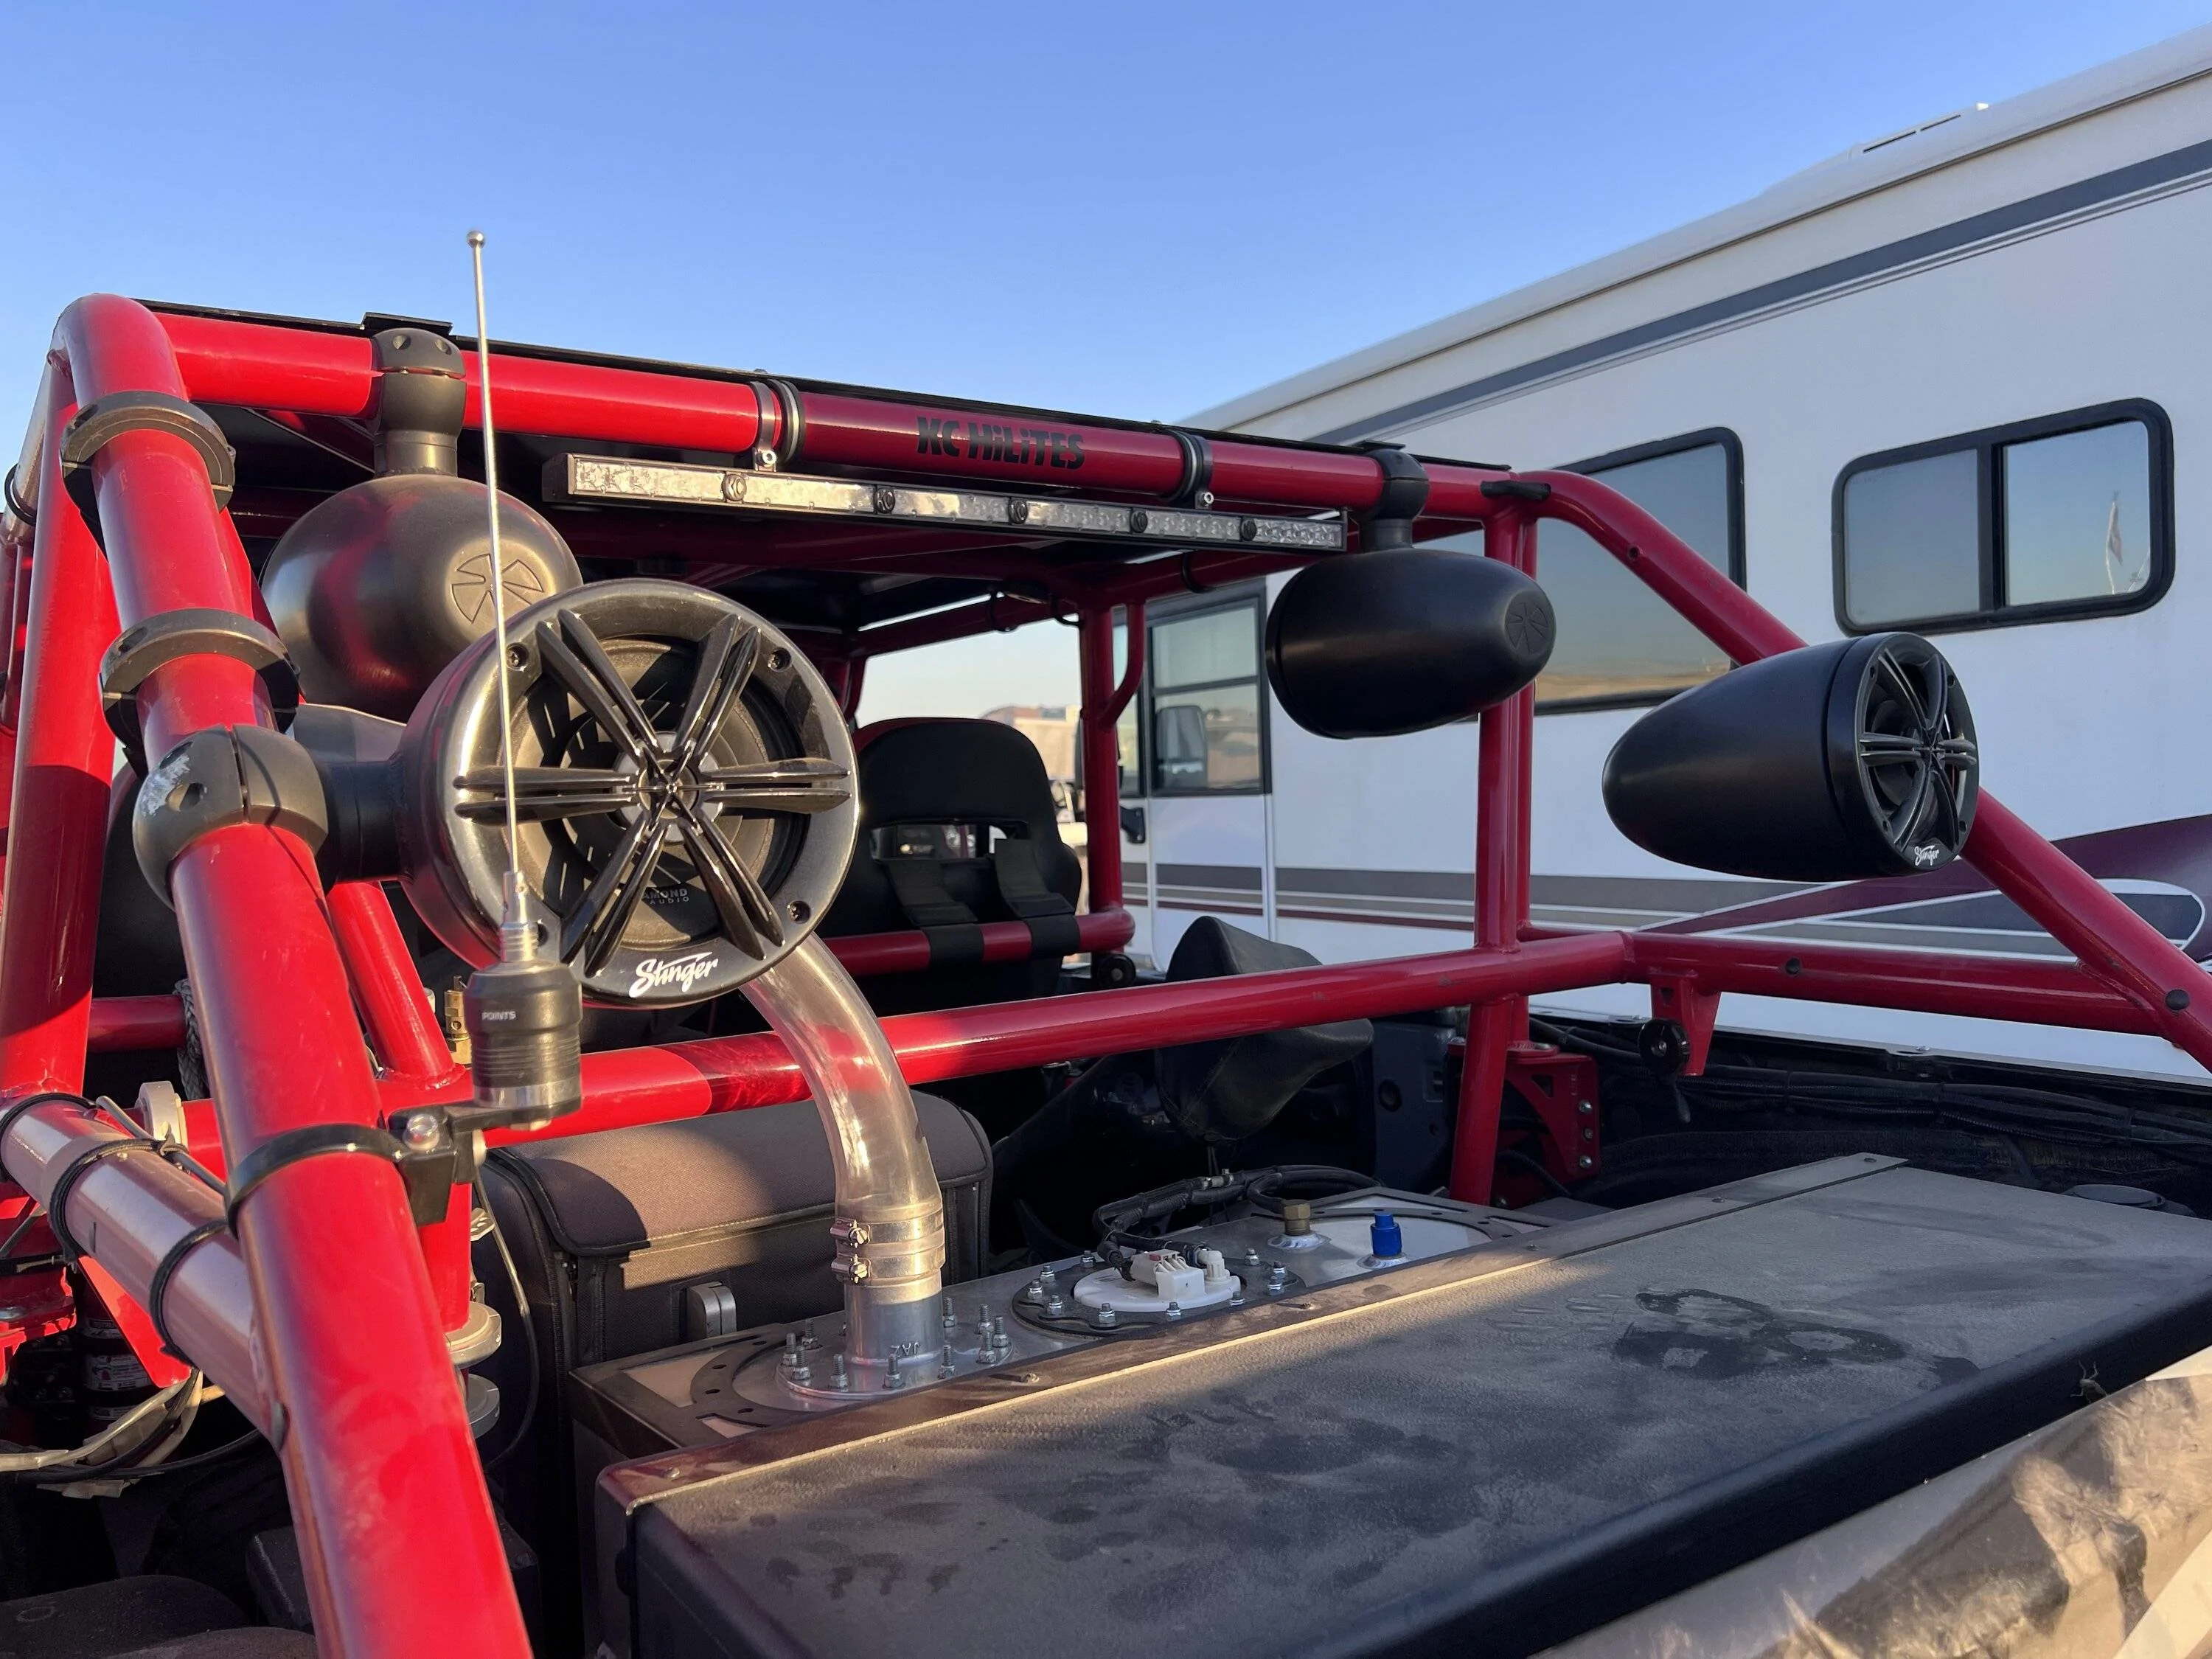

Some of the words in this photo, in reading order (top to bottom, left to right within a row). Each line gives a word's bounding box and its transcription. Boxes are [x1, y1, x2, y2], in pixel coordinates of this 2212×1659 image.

[917, 416, 961, 457] KC
[876, 489, 894, 511] KC
[1914, 845, 1940, 866] Stinger
[643, 888, 688, 900] AMOND
[650, 896, 689, 905] AUDIO
[628, 951, 719, 998] Stinger
[481, 1011, 516, 1021] POINTS
